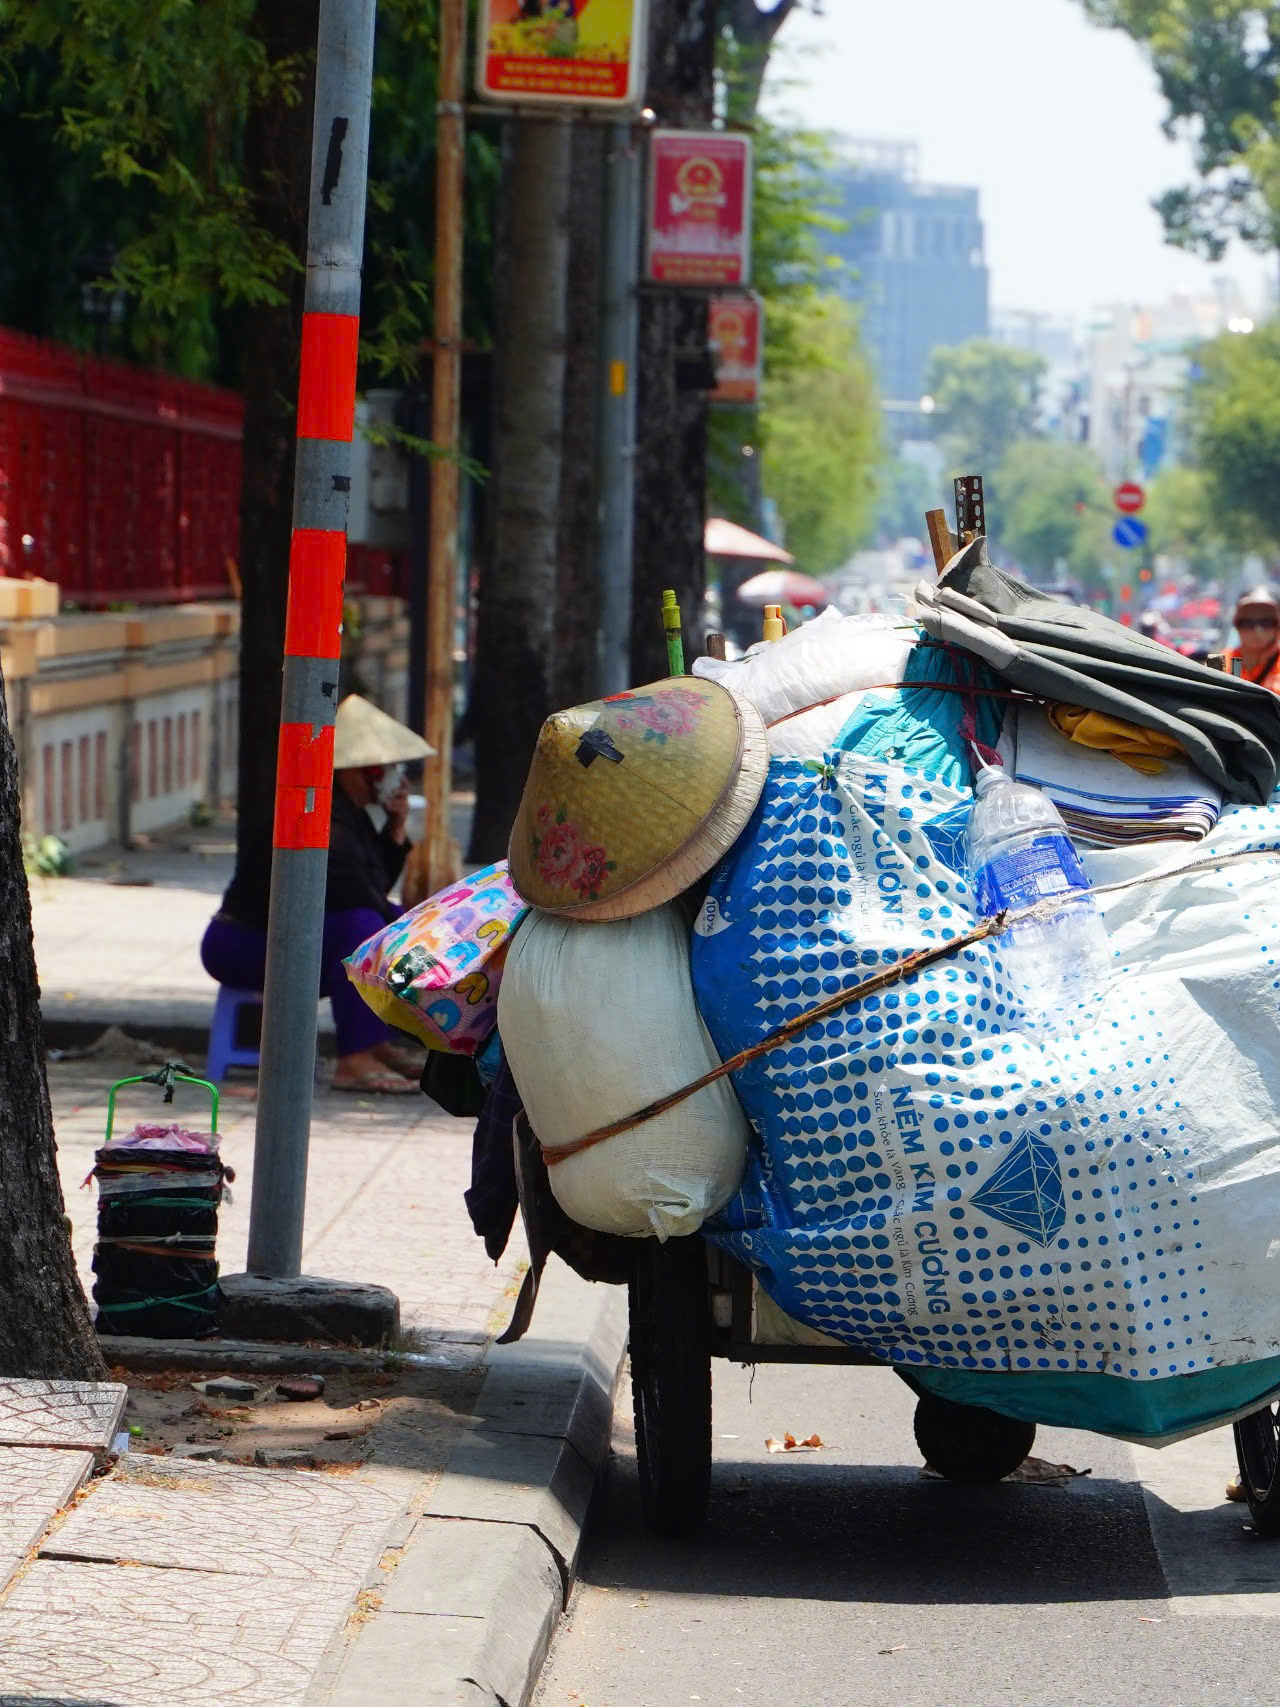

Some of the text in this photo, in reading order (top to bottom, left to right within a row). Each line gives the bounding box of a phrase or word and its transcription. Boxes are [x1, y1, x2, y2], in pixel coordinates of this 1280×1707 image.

[863, 773, 888, 827] KIM
[852, 835, 866, 859] ngủ
[856, 861, 866, 872] là
[1009, 894, 1021, 904] 5L
[706, 900, 716, 933] 100%
[874, 1091, 883, 1113] Sức
[877, 1115, 891, 1146] khỏe
[886, 1149, 895, 1159] là
[892, 1161, 906, 1190] Vàng
[890, 1085, 950, 1315] NỆM KIM CƯƠNG
[892, 1199, 904, 1224] Giấc
[893, 1227, 908, 1246] ngủ
[899, 1249, 909, 1258] là
[902, 1260, 912, 1278] Kim
